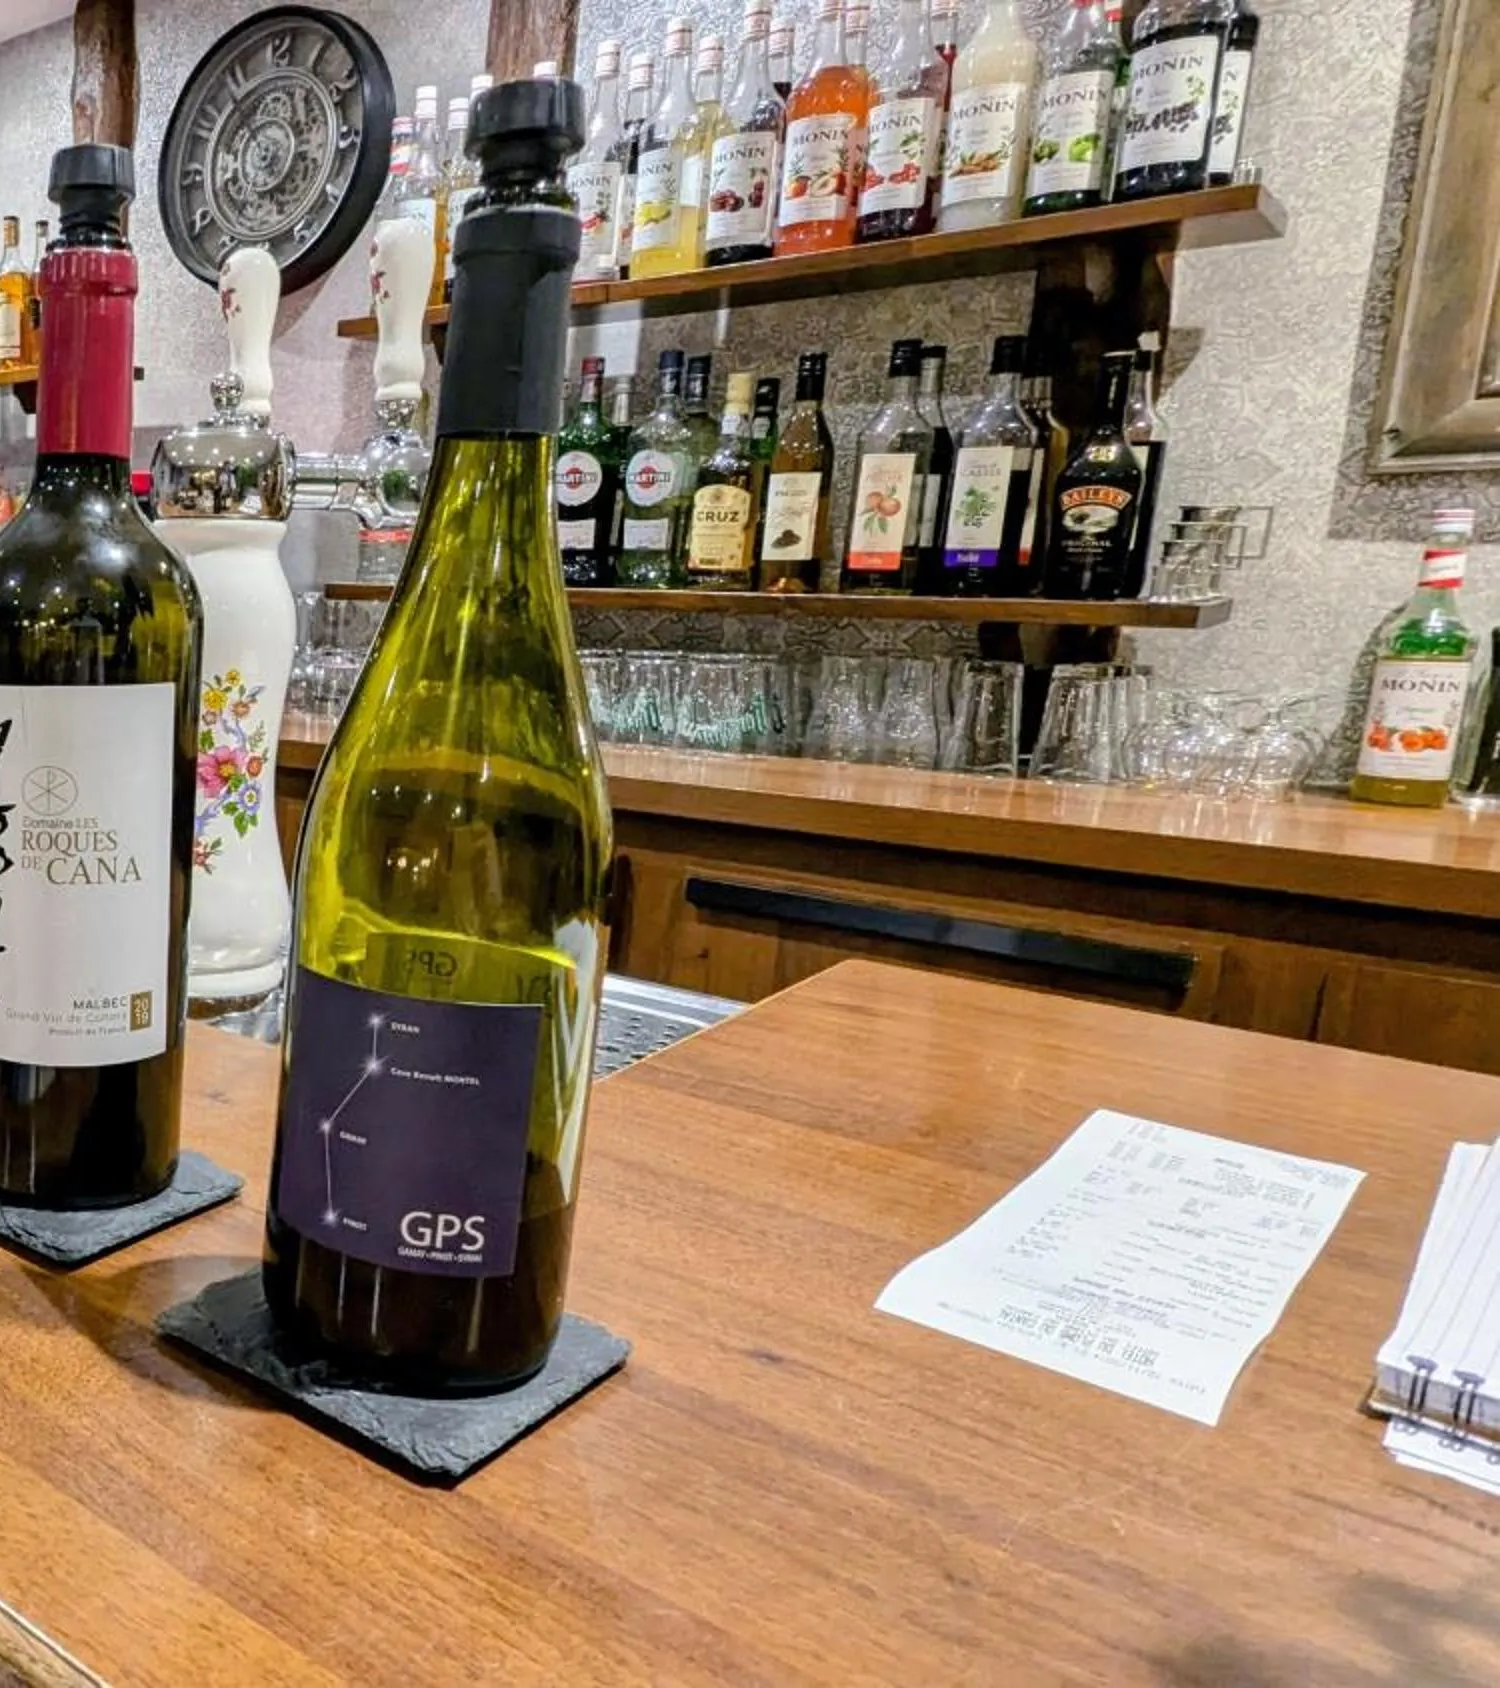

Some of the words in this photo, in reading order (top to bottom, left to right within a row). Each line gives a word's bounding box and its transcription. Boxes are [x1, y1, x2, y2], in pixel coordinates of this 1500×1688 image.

[952, 98, 1015, 120] MONIN
[1042, 88, 1107, 110] MONIN
[792, 127, 850, 147] MONIN
[1061, 486, 1127, 508] BAILEYS
[695, 510, 740, 522] CRUZ
[1379, 676, 1460, 693] MONIN
[75, 818, 99, 829] LES
[21, 829, 119, 858] ROQUES
[21, 855, 43, 870] DE
[46, 855, 142, 885] CANA
[73, 995, 128, 1010] MALBEC
[400, 1210, 486, 1251] GPS
